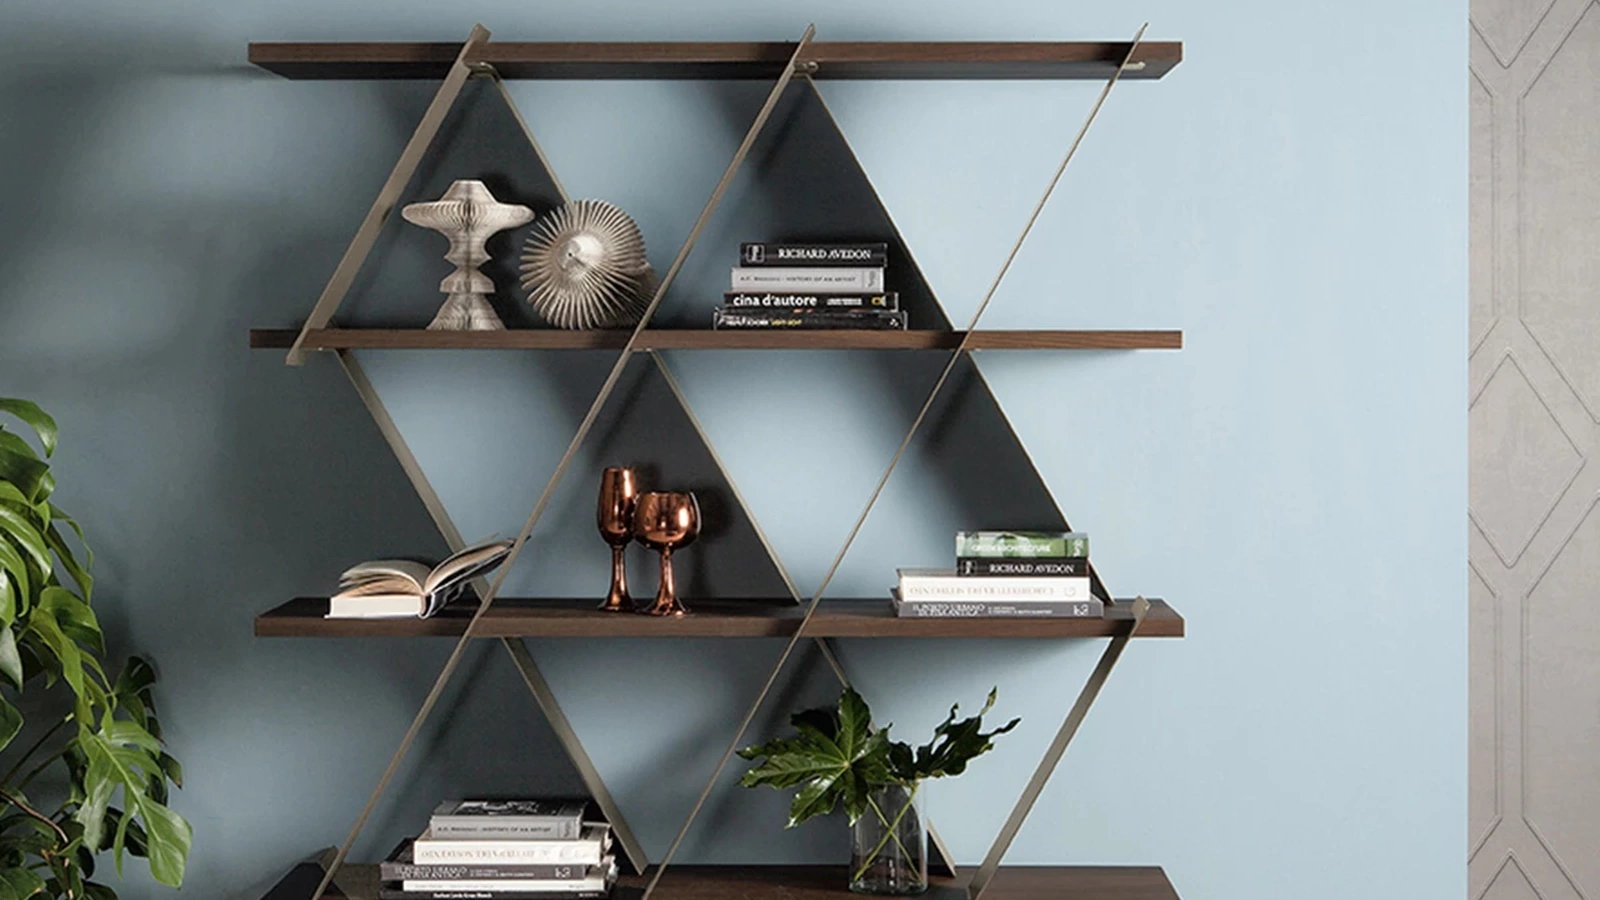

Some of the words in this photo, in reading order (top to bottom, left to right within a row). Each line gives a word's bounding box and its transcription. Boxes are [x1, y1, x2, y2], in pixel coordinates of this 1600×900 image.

[778, 248, 827, 259] RICHARD
[828, 248, 871, 260] AVEDON
[733, 294, 760, 306] cina
[762, 293, 818, 306] d'autore
[989, 563, 1034, 573] RICHARD
[1034, 563, 1075, 574] AVEDON
